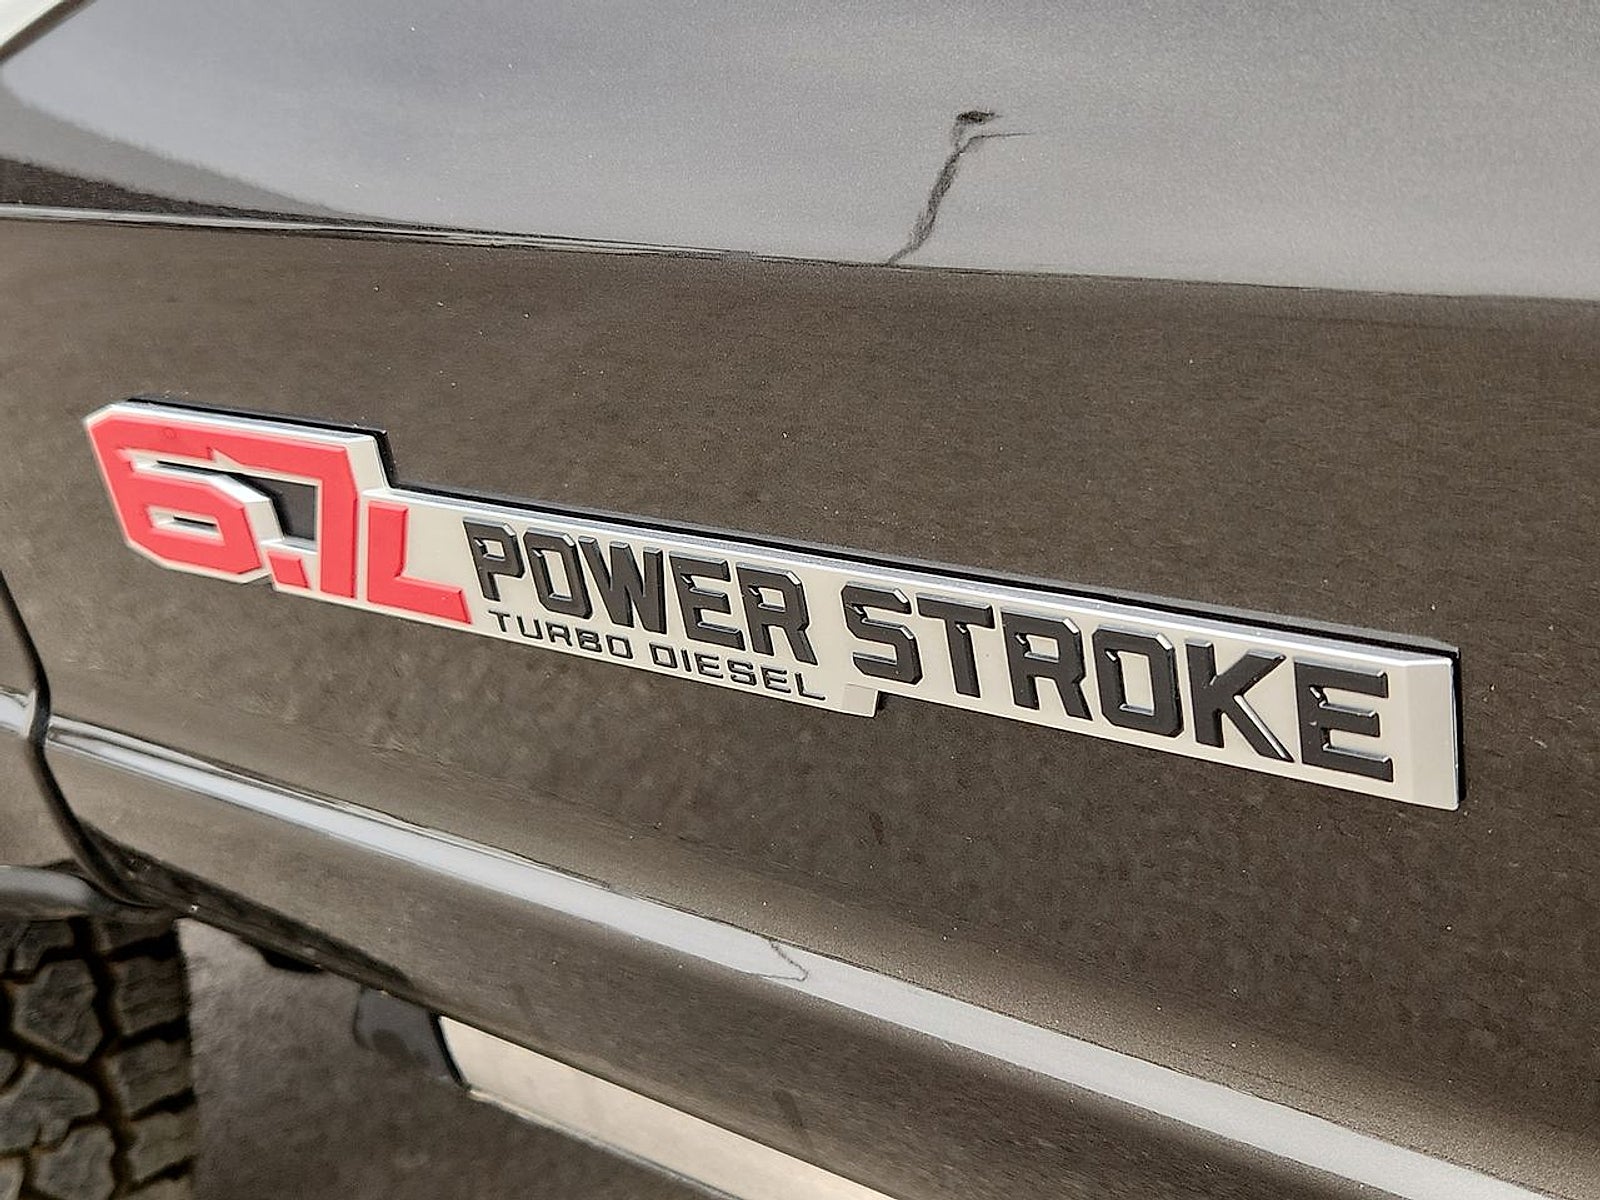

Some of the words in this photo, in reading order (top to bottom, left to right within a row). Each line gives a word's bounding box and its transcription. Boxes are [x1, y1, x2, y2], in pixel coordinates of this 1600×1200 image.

[462, 518, 818, 666] POWER
[841, 581, 1394, 783] STROKE
[488, 610, 632, 661] TURBO
[651, 645, 826, 701] DIESEL
